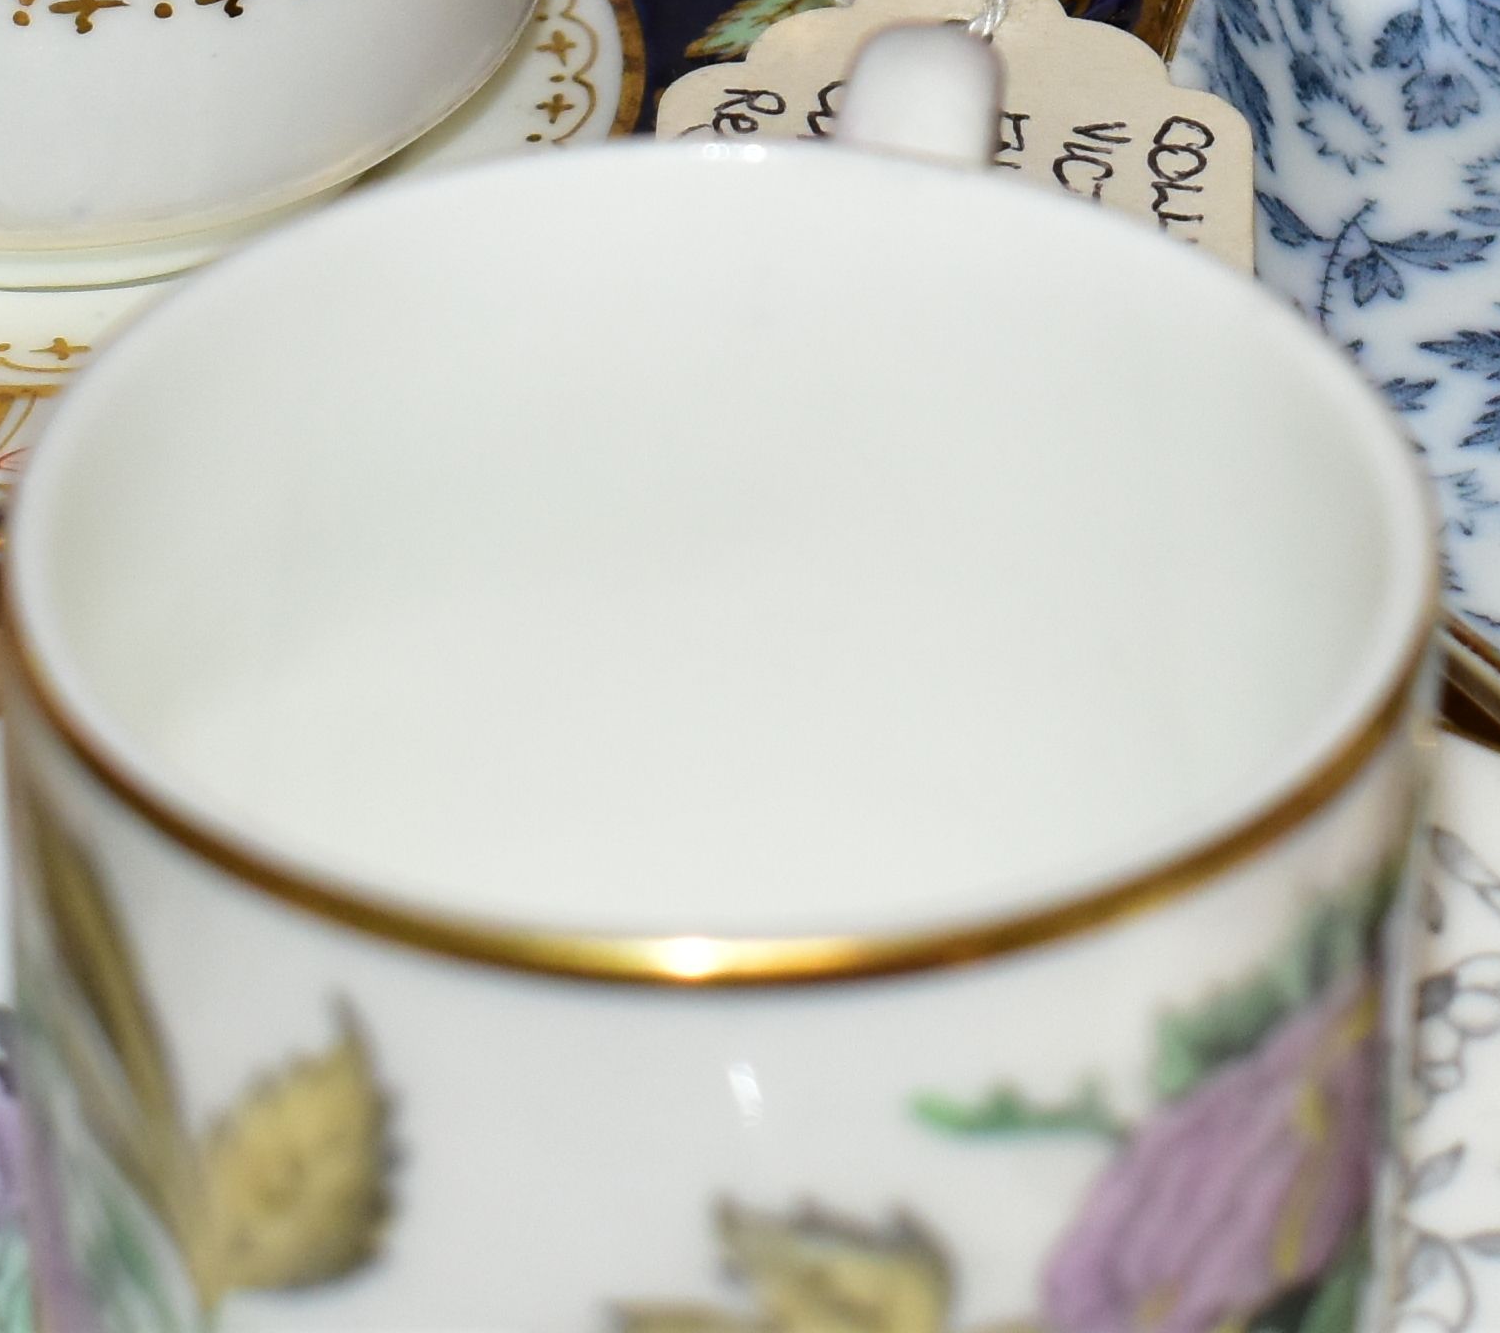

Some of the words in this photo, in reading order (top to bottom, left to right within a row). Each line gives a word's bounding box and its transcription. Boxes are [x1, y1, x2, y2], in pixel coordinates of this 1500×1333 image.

[675, 87, 786, 137] Re
[1052, 121, 1132, 202] VIC
[1148, 115, 1215, 244] COLL
